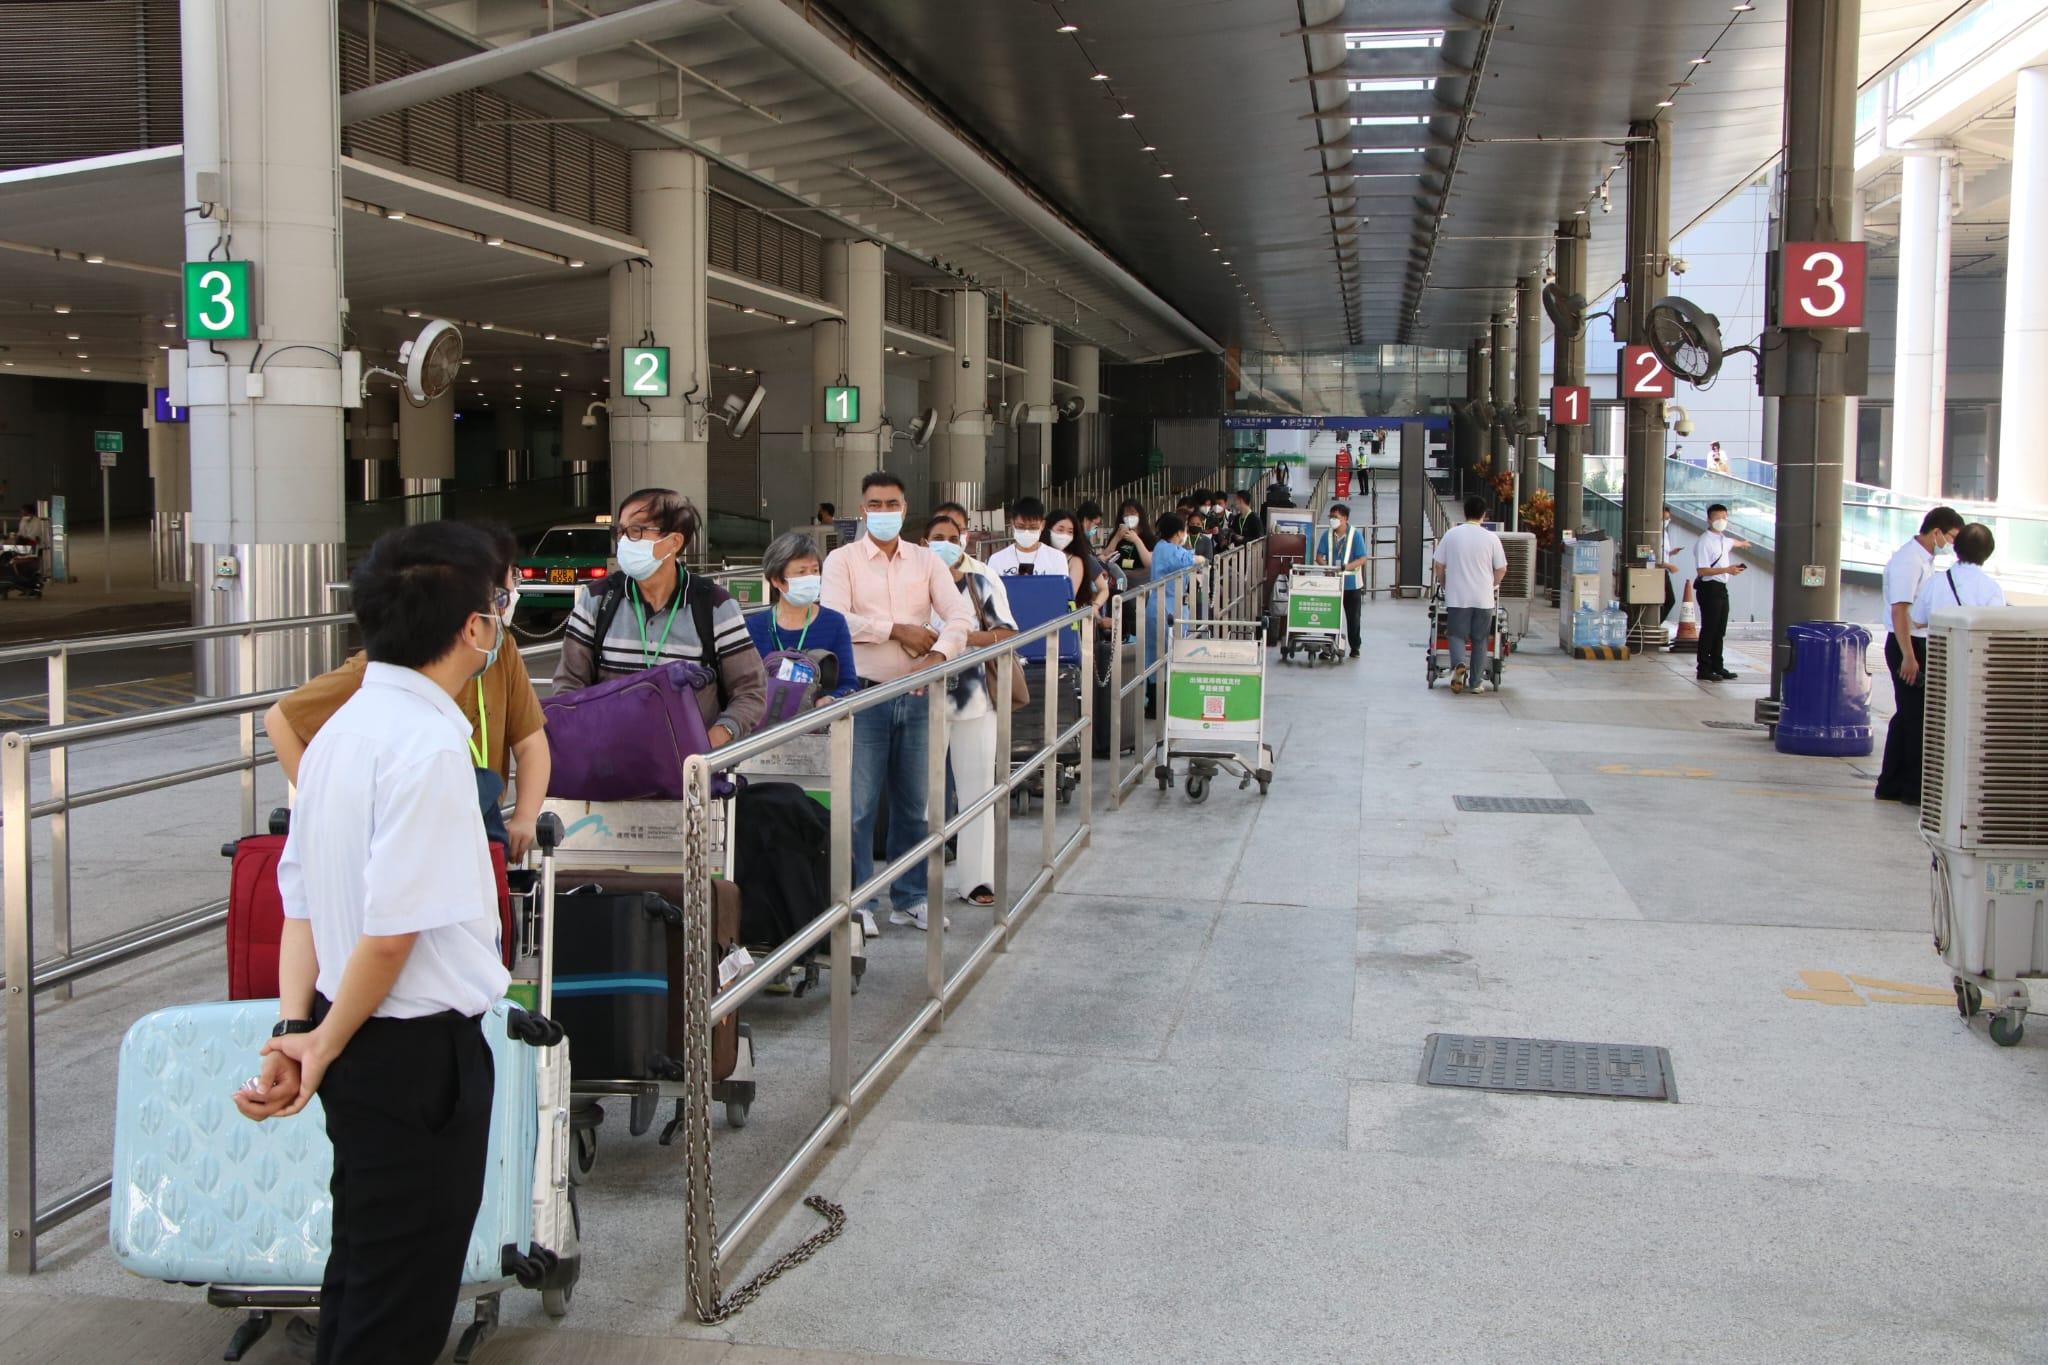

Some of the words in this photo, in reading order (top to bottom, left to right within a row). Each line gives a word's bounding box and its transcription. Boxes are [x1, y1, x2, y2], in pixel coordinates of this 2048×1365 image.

[199, 270, 235, 331] 3
[1800, 251, 1846, 318] 3
[632, 352, 659, 392] 2
[1633, 351, 1663, 392] 2
[836, 390, 849, 420] 1
[1564, 390, 1578, 420] 1
